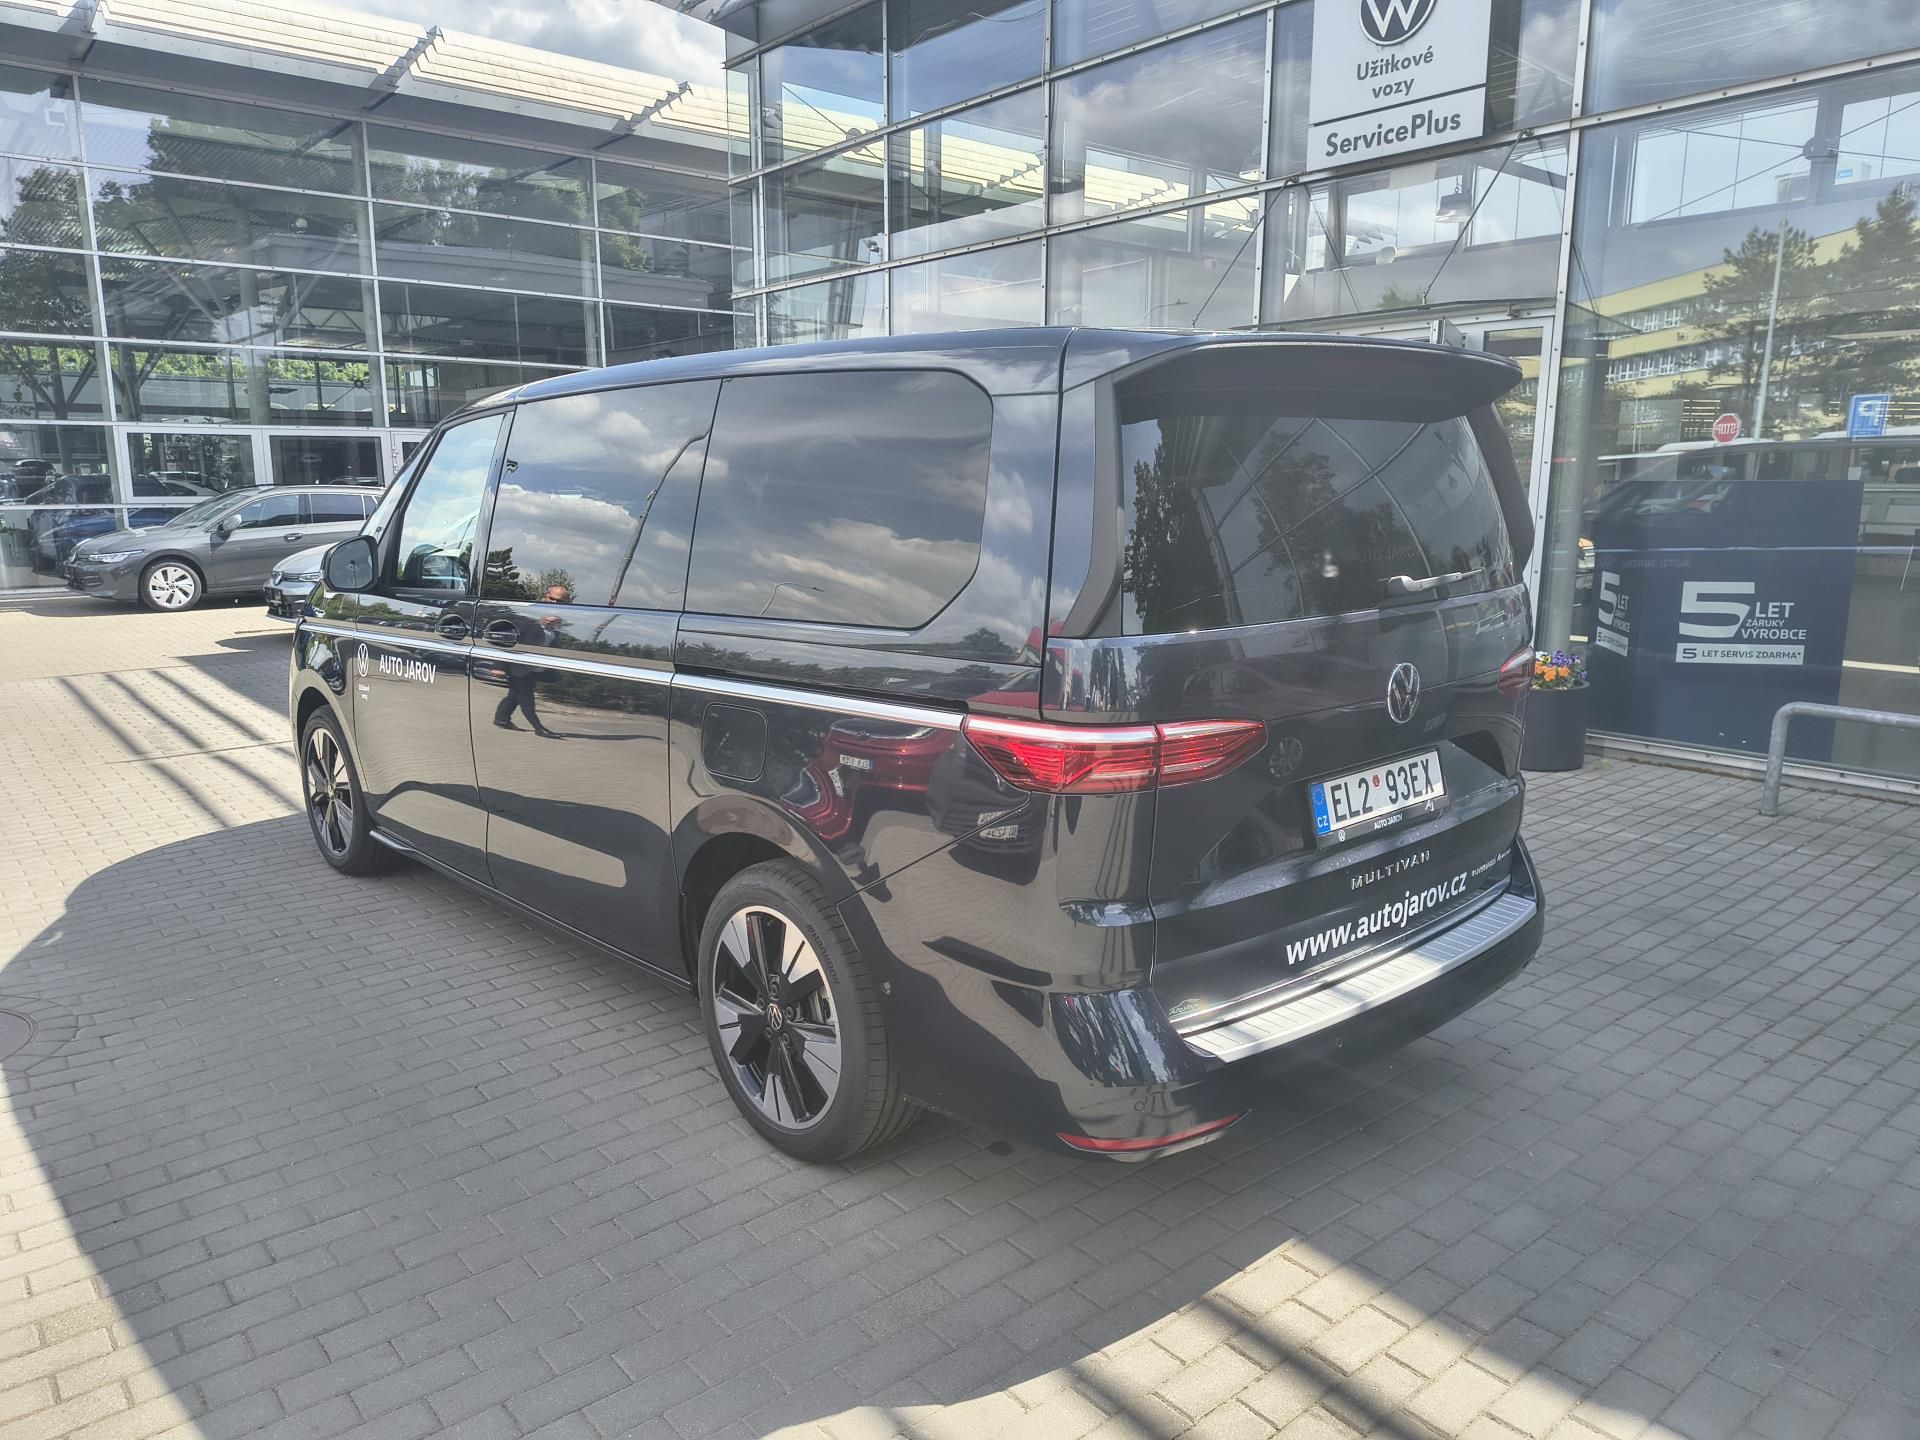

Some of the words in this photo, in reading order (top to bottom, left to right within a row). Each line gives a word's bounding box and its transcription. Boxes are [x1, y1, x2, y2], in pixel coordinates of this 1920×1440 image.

[1357, 46, 1434, 81] Užitkové
[1372, 78, 1415, 98] vozy
[1325, 110, 1462, 157] ServicePlus
[1679, 581, 1756, 638] 5
[1745, 617, 1785, 628] ZÁRUKY
[1755, 601, 1795, 618] LET
[1741, 626, 1808, 640] VÝROBCE
[379, 654, 403, 678] AUTO
[404, 661, 436, 684] JAROV
[1682, 648, 1698, 660] 5
[1702, 650, 1719, 658] LET
[1720, 650, 1754, 659] SERVIS
[1330, 778, 1374, 824] EL2
[1385, 758, 1436, 805] 93EX
[1317, 815, 1329, 828] CZ
[1351, 850, 1431, 891] MULTIVAN
[1286, 871, 1468, 966] www.autojarov.cz
